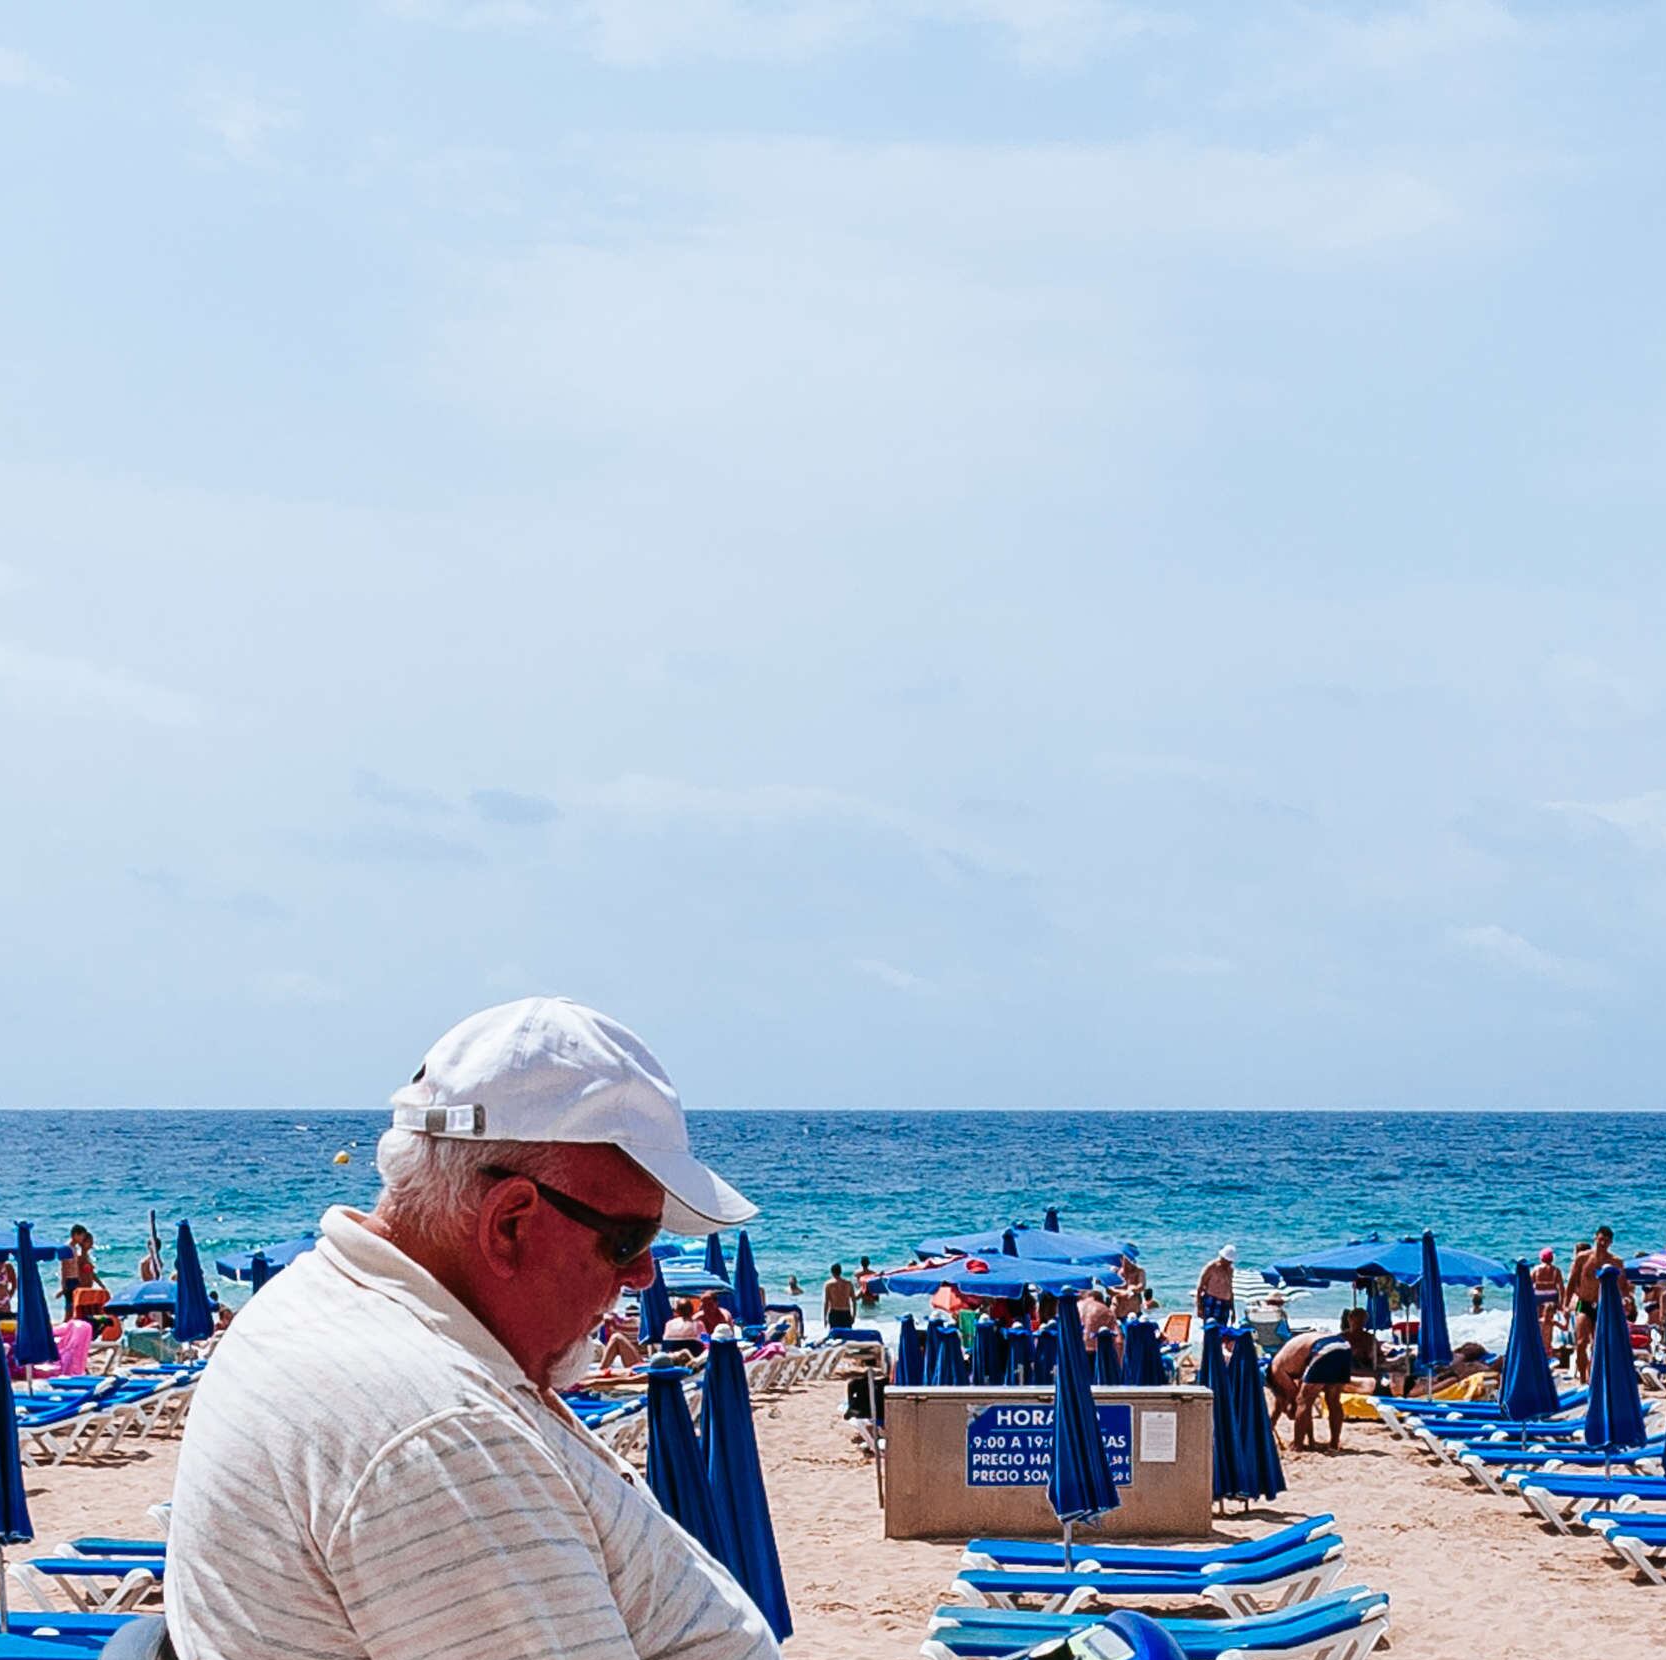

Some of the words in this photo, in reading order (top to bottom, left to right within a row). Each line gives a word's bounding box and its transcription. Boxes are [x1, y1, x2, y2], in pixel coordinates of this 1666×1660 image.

[974, 1436, 1006, 1449] 9:00
[1011, 1436, 1022, 1448] A
[1027, 1436, 1053, 1449] 19:
[973, 1453, 1025, 1466] PRECIO
[973, 1469, 1019, 1482] PRECIO
